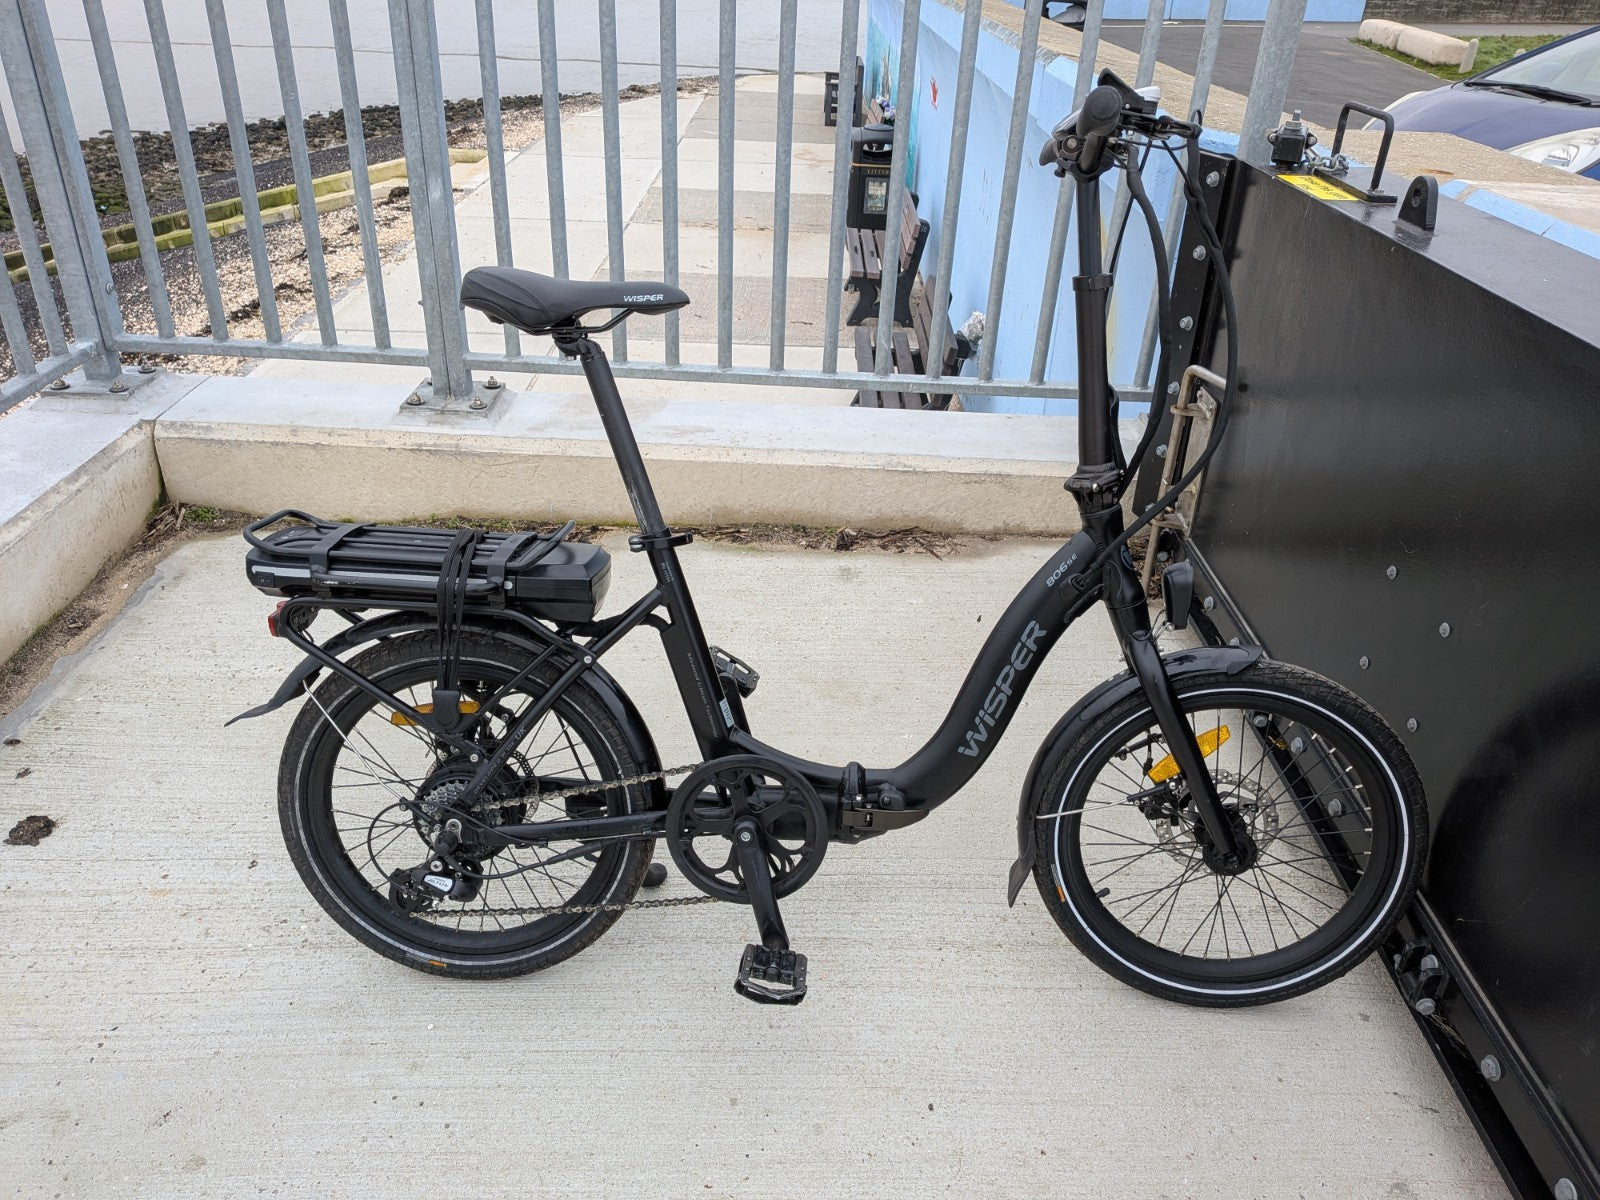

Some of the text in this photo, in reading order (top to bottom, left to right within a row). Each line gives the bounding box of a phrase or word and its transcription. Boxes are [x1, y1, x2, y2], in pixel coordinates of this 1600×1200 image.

[624, 294, 664, 302] WISPER
[957, 620, 1047, 757] WISPER
[514, 726, 526, 740] UK
